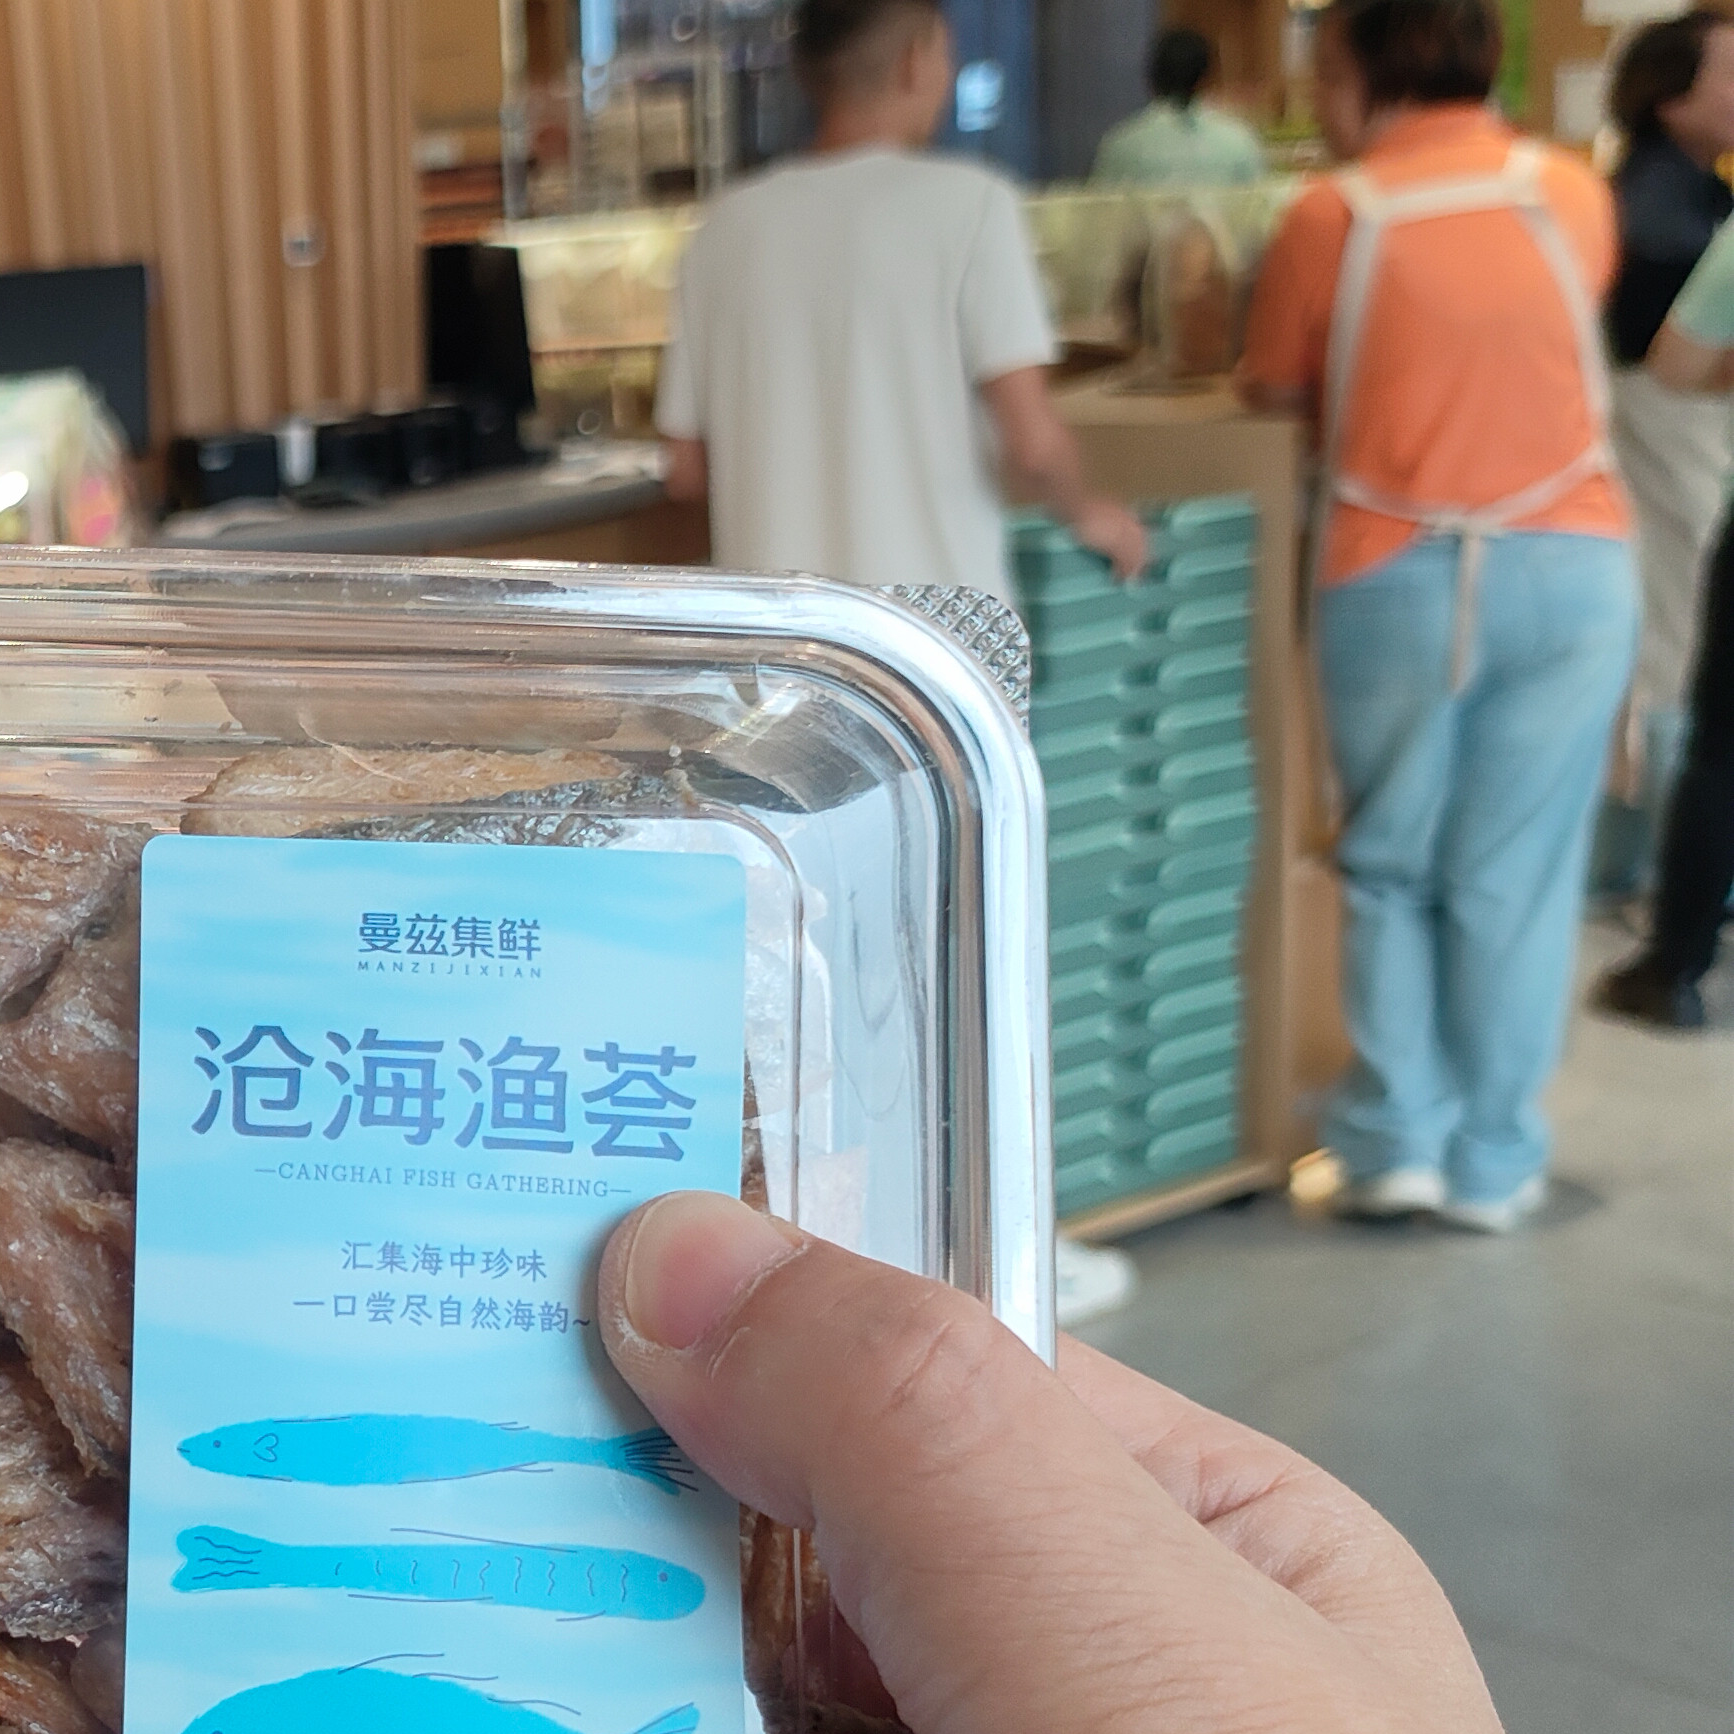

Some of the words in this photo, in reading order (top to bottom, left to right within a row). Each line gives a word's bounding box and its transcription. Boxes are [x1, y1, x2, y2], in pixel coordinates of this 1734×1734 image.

[358, 912, 542, 961] 曼兹集鲜
[357, 960, 542, 978] MANZIJIXIAN
[191, 1025, 697, 1162] 沧海渔荟
[403, 1169, 457, 1189] FISH
[341, 1239, 547, 1282] 汇集海中珍味
